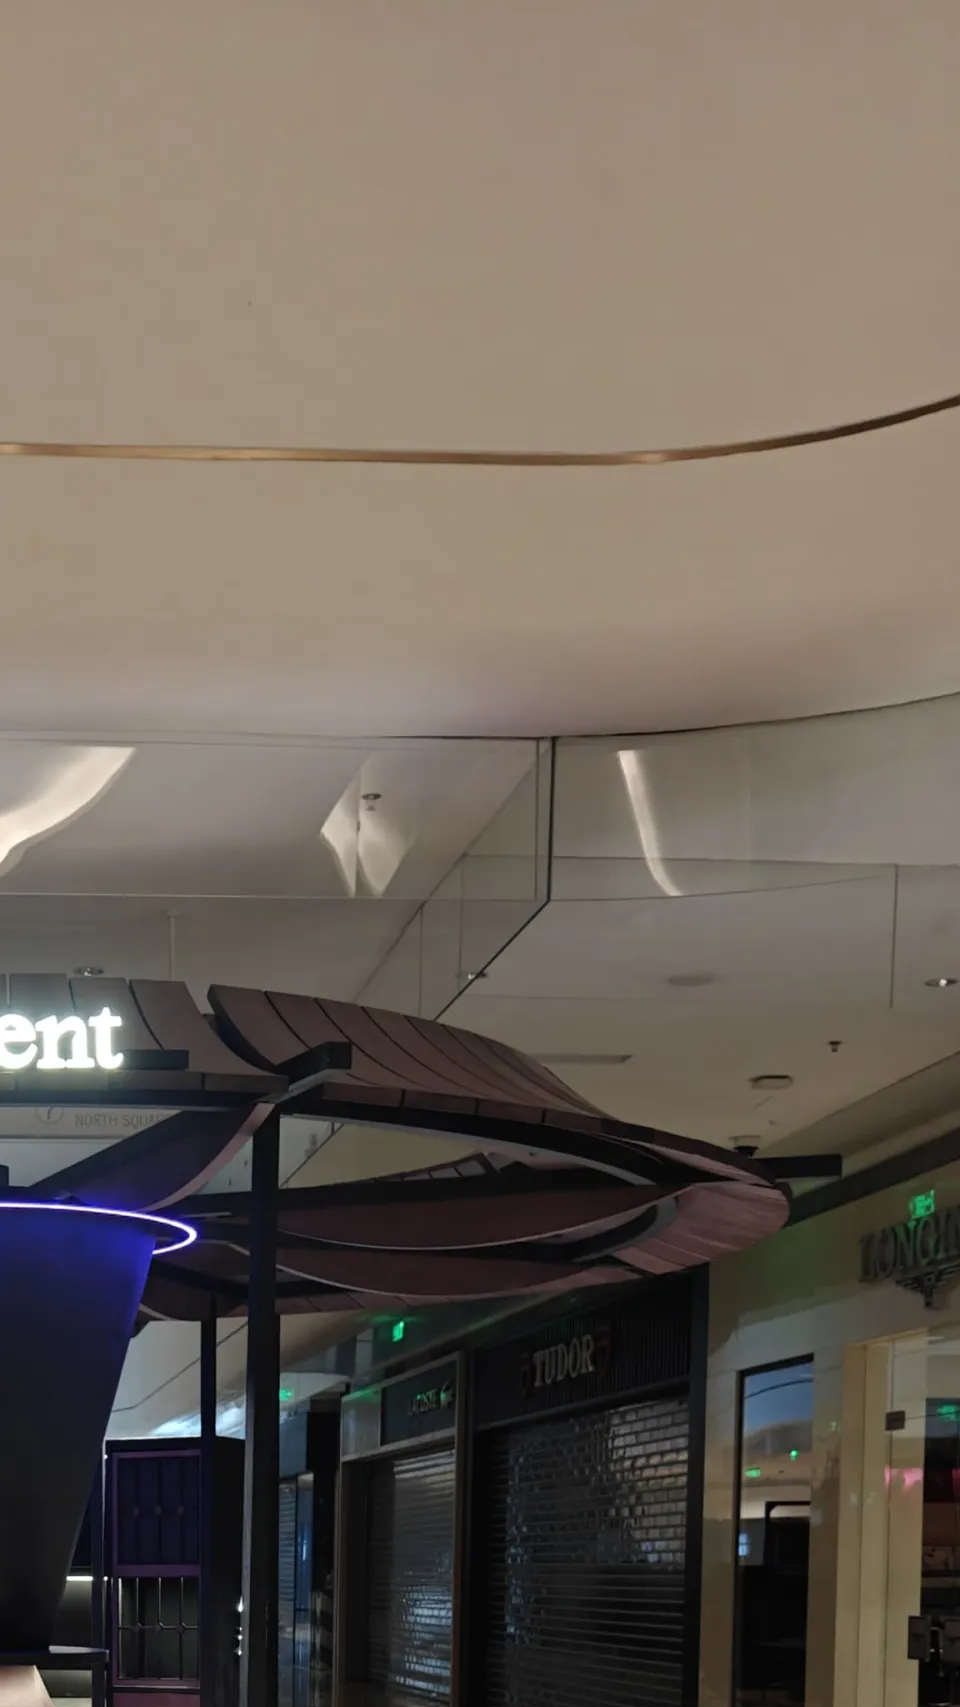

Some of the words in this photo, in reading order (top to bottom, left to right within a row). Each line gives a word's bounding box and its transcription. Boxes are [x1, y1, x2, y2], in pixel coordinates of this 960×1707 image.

[75, 1114, 117, 1127] NORTH
[122, 1114, 173, 1129] SQUA
[533, 1334, 595, 1387] TUDOR
